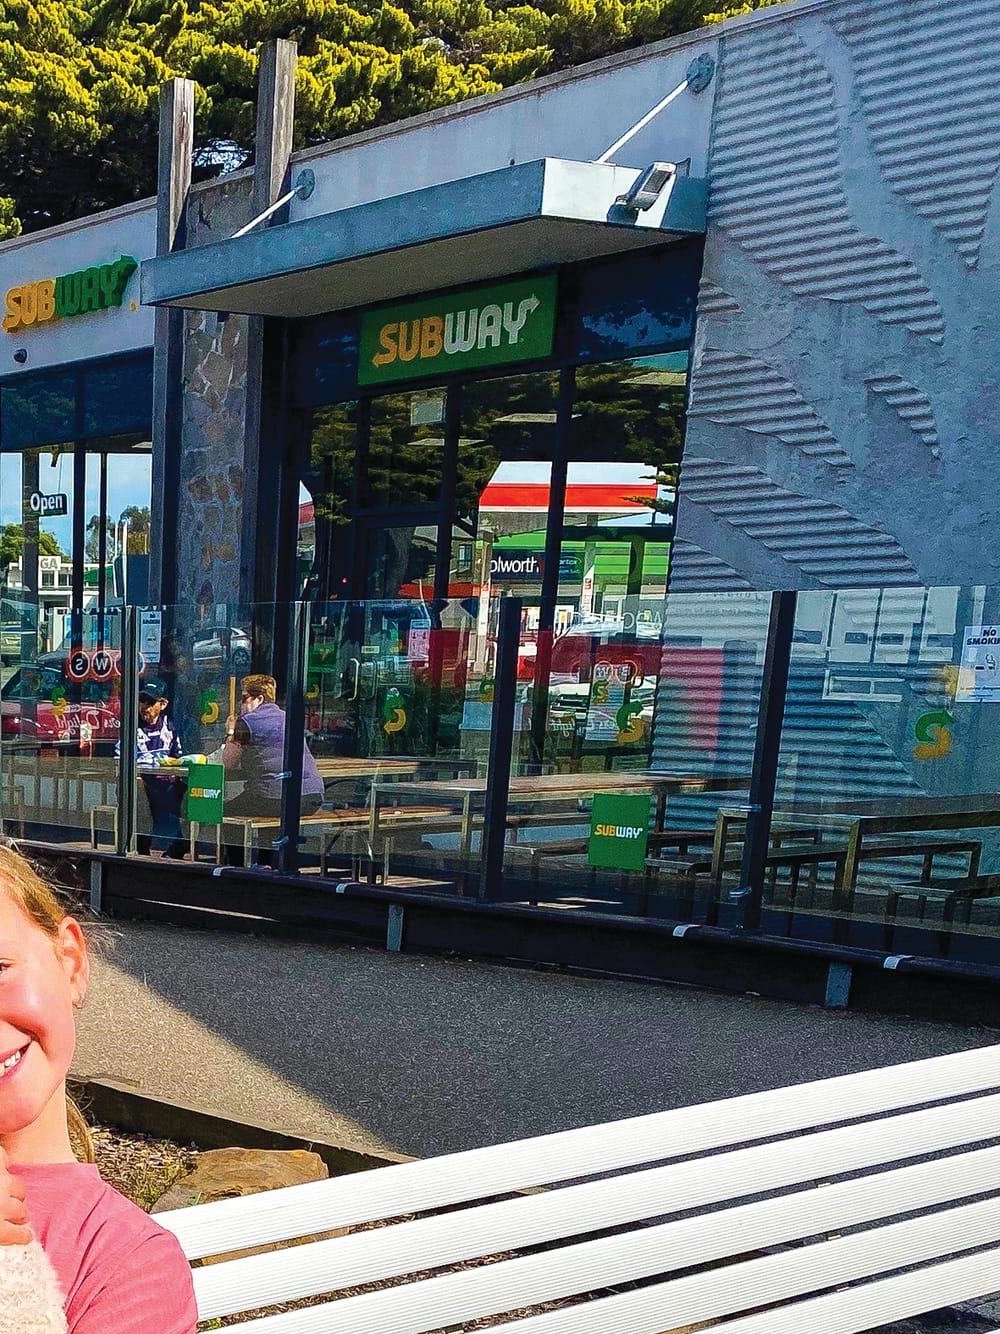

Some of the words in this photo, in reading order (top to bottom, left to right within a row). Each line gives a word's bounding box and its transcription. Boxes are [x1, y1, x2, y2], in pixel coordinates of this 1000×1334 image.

[2, 254, 138, 334] SUBWAY
[372, 294, 540, 368] SUBWAY
[30, 492, 63, 514] Open
[40, 557, 59, 570] GA
[490, 556, 539, 573] olworth
[983, 629, 997, 637] NO
[594, 824, 643, 839] SUBWAY
